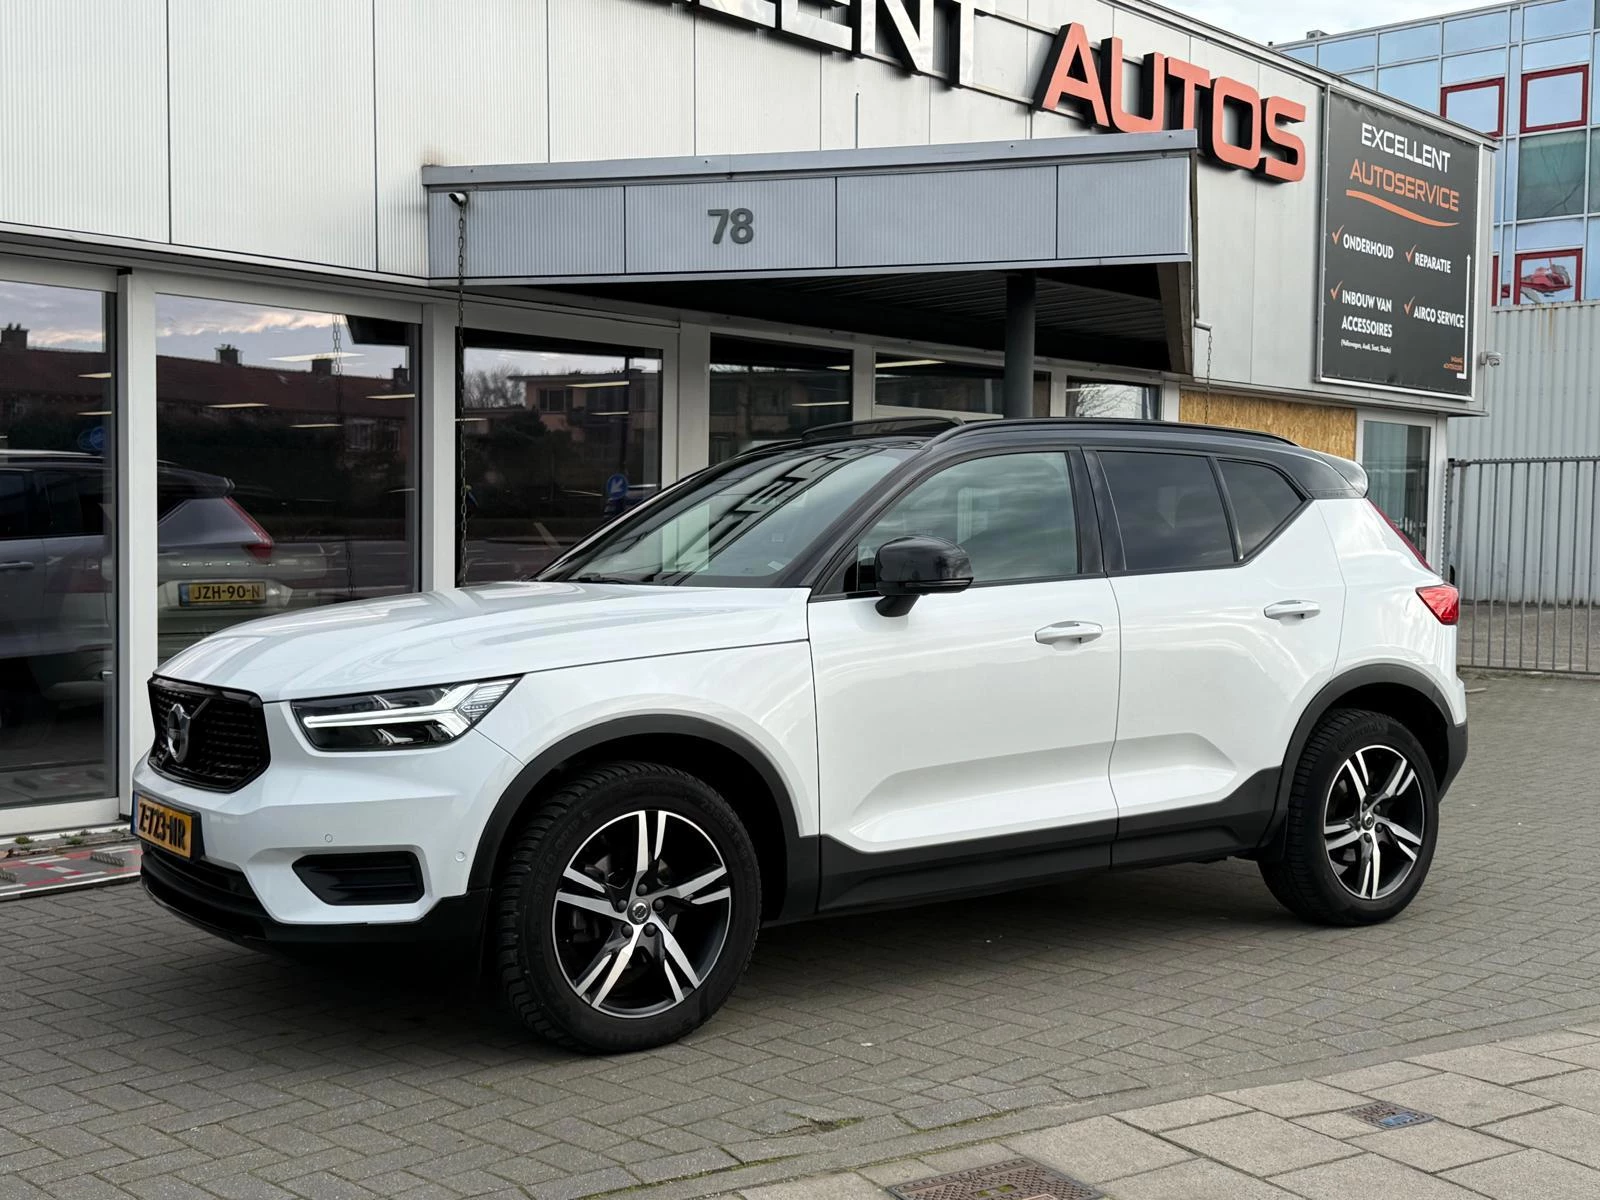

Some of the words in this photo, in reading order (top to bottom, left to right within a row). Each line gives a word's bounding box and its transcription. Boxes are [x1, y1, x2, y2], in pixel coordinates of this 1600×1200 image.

[1040, 21, 1306, 182] AUTOS
[1361, 122, 1451, 173] EXCELLENT
[1349, 158, 1459, 212] AUTOSERVICE
[707, 207, 754, 245] 78
[1342, 233, 1394, 259] ONDERHOUD
[1414, 252, 1452, 274] REPARATIE
[1342, 289, 1376, 309] INBOUW
[1376, 296, 1392, 313] VAN
[1341, 315, 1393, 338] ACCESSOIRES
[1413, 305, 1436, 323] AIRCO
[1436, 309, 1465, 328] SERVICE
[194, 585, 260, 600] JZH-90-N
